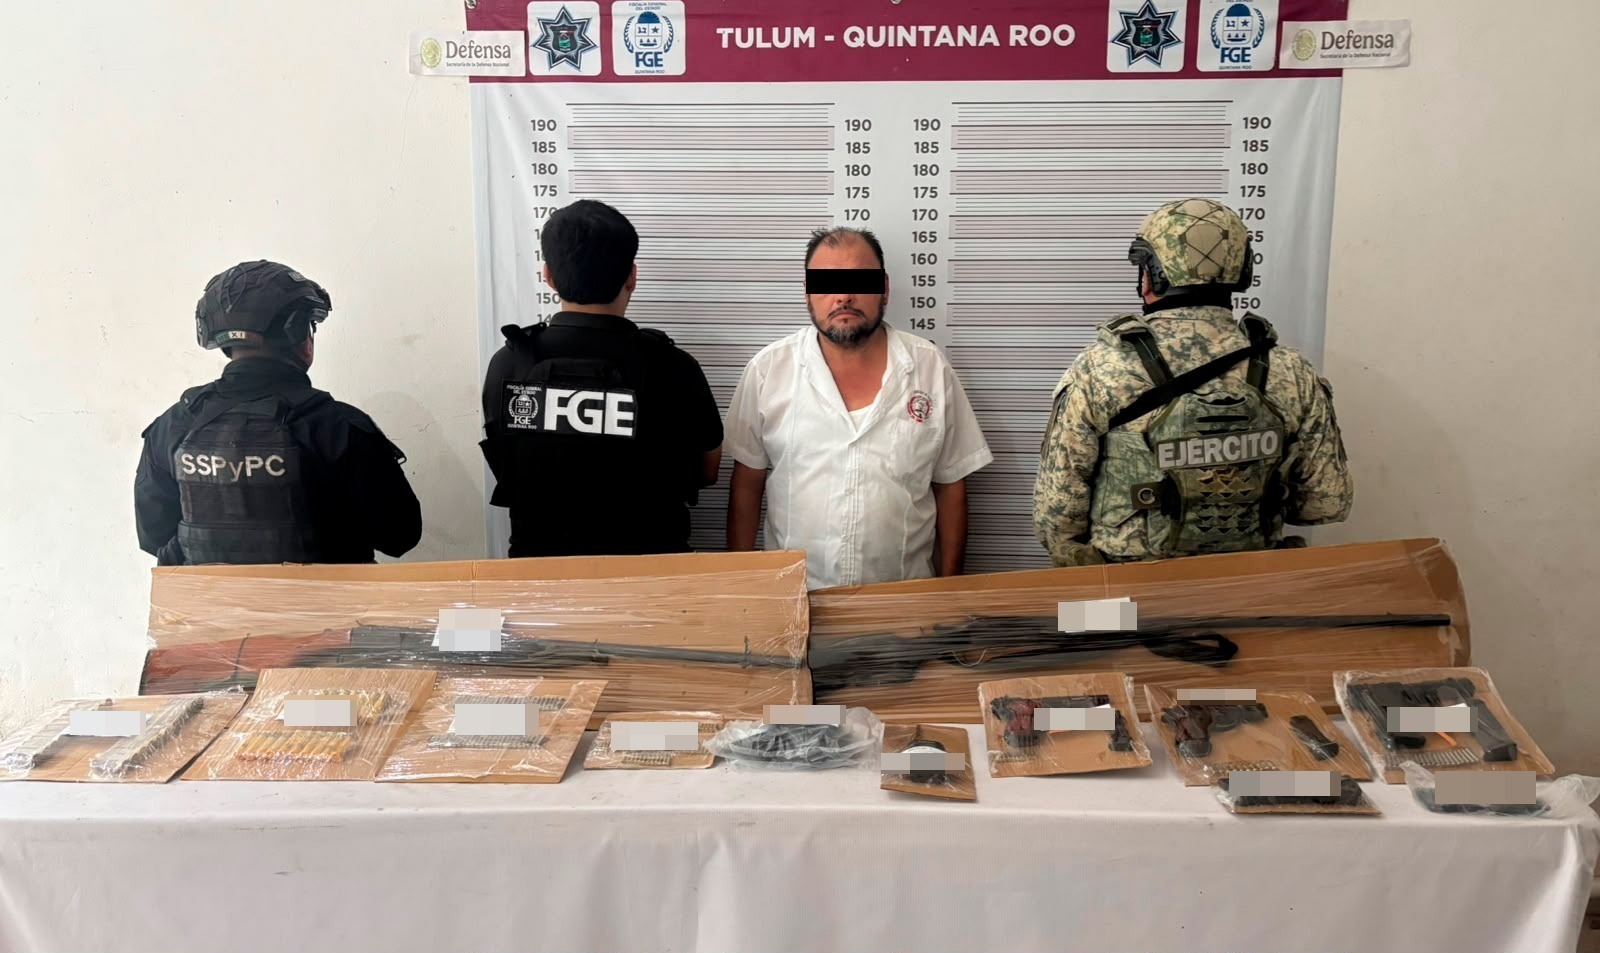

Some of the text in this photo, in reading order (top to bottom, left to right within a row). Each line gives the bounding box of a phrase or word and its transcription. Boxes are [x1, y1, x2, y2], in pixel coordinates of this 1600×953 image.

[716, 26, 816, 49] TULUM
[843, 25, 1000, 48] QUINTANA
[1009, 24, 1076, 47] ROO
[1320, 29, 1394, 50] Defensa
[445, 40, 511, 59] Defensa
[1220, 47, 1251, 63] FGE
[635, 51, 664, 68] FGE
[530, 119, 557, 132] 190
[845, 119, 872, 132] 190
[913, 118, 941, 131] 190
[1242, 117, 1272, 129] 190
[532, 141, 557, 153] 185
[845, 142, 871, 154] 185
[913, 141, 940, 154] 185
[1242, 140, 1269, 152] 185
[531, 163, 558, 175] 180
[844, 164, 871, 176] 180
[912, 164, 940, 176] 180
[1240, 162, 1269, 175] 180
[533, 185, 558, 197] 175
[845, 186, 870, 199] 175
[912, 186, 938, 199] 175
[1239, 185, 1266, 198] 175
[844, 209, 871, 221] 170
[911, 208, 938, 221] 170
[1238, 207, 1266, 220] 170
[911, 231, 938, 243] 165
[1247, 230, 1264, 242] 65
[910, 253, 938, 265] 160
[911, 275, 936, 287] 155
[536, 293, 561, 304] 150
[910, 296, 937, 309] 150
[1232, 297, 1261, 309] 150
[910, 318, 936, 330] 145
[544, 388, 634, 436] FGE
[514, 415, 531, 425] FGE
